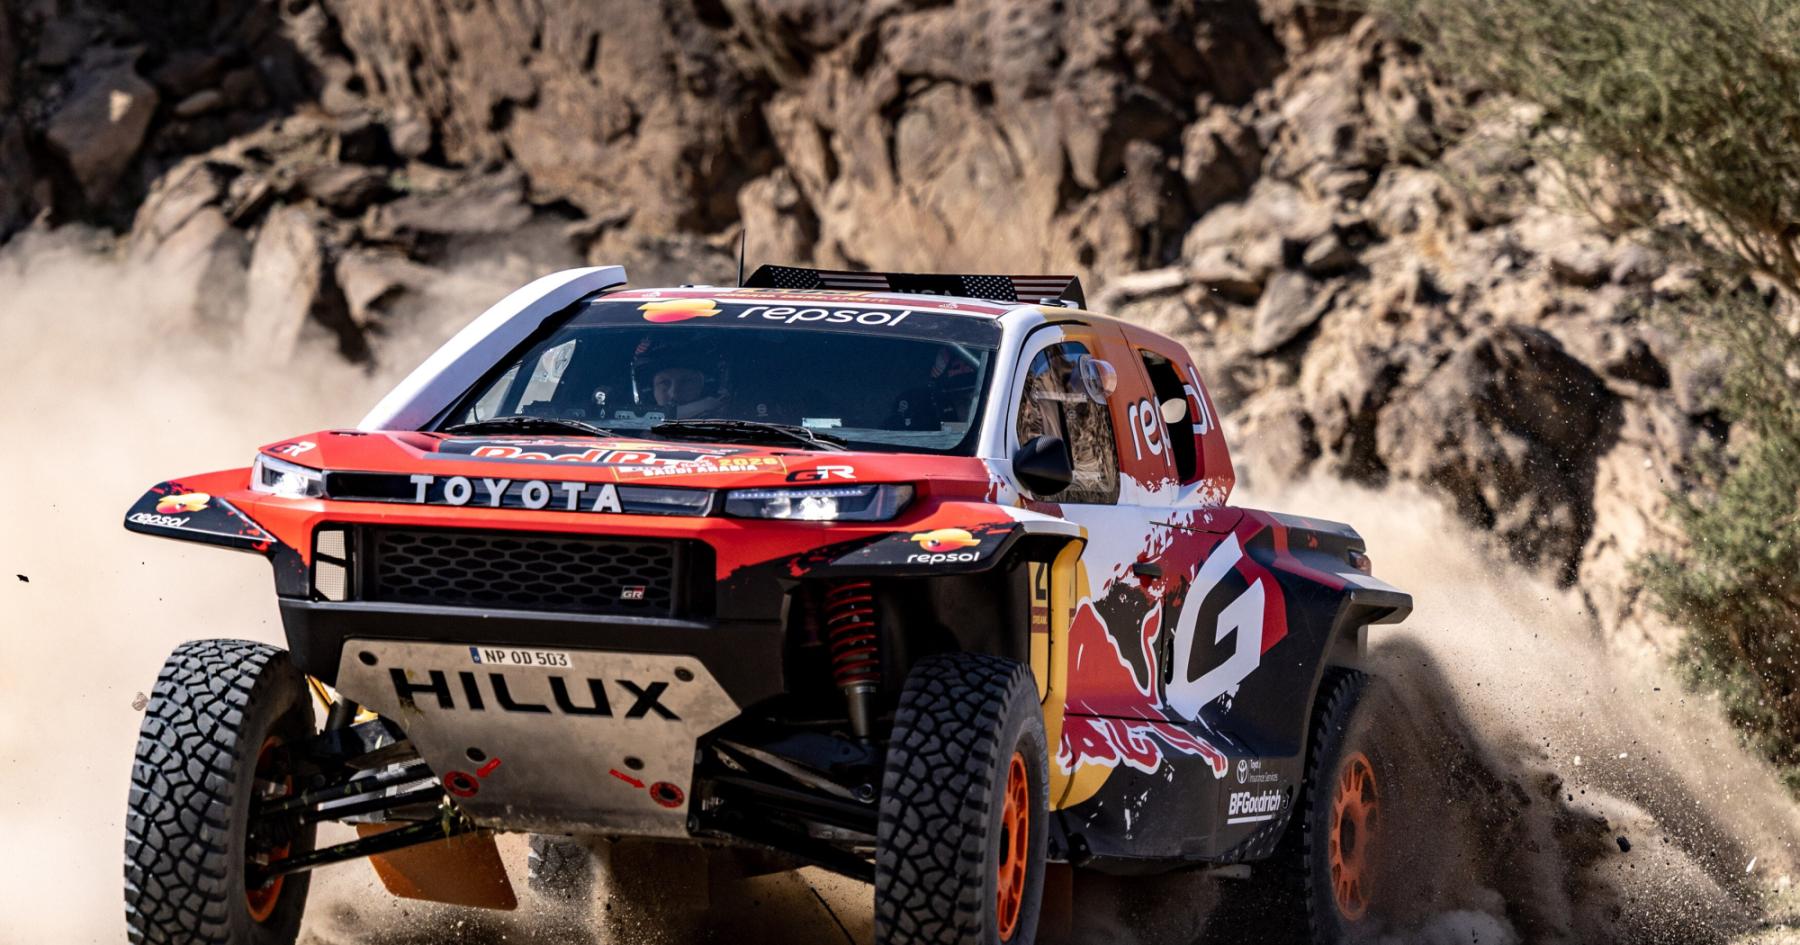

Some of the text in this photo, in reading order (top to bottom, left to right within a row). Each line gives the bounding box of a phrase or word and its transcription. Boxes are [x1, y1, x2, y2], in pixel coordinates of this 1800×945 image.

[737, 306, 911, 327] repsol
[785, 465, 857, 482] GR
[410, 474, 622, 513] TOYOTA
[129, 512, 190, 527] repsol
[907, 551, 980, 565] repsol
[622, 590, 643, 599] GR
[484, 649, 506, 663] NP
[535, 652, 568, 666] 503
[389, 668, 683, 722] HILUX
